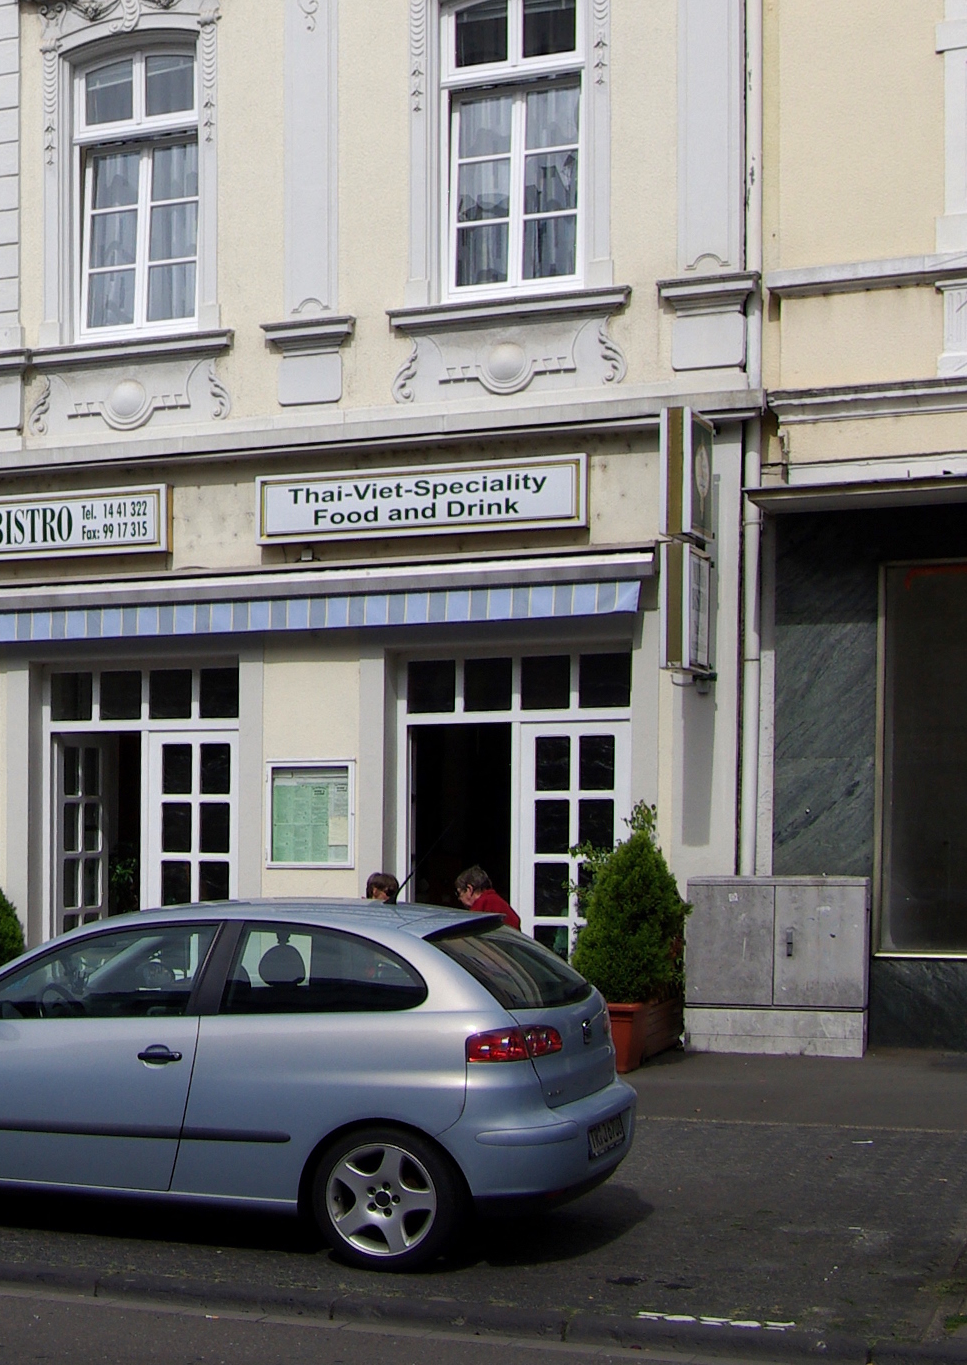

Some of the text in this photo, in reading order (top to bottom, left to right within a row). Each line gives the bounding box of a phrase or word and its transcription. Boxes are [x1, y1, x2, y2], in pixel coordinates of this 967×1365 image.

[288, 473, 547, 505] Thai-Viet-Speciality
[81, 503, 97, 520] Tel.
[313, 497, 519, 526] Food and Drink
[81, 525, 100, 541] Fax:
